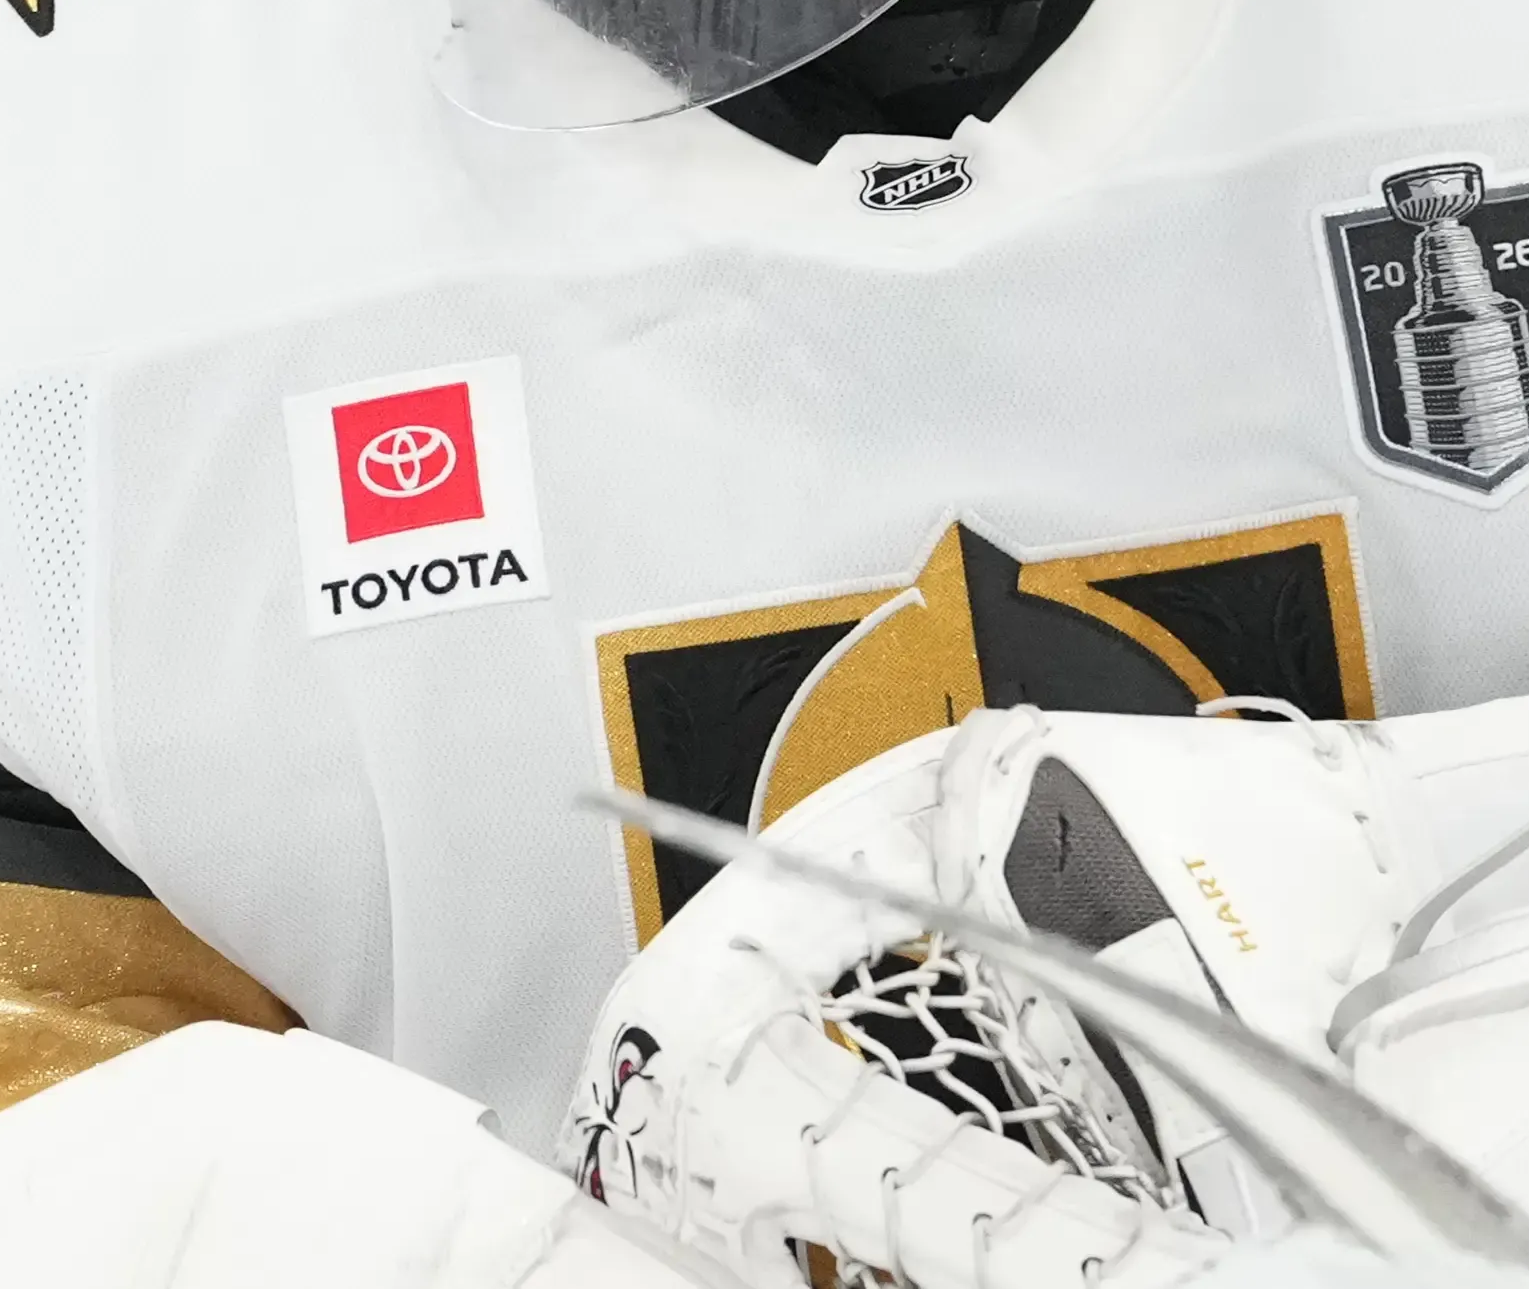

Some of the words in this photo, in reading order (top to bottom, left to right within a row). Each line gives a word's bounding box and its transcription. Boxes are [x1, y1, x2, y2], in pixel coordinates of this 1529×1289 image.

[883, 166, 953, 204] NHL
[1360, 261, 1406, 292] 20
[321, 549, 529, 615] TOYOTA
[1181, 857, 1258, 952] HART
